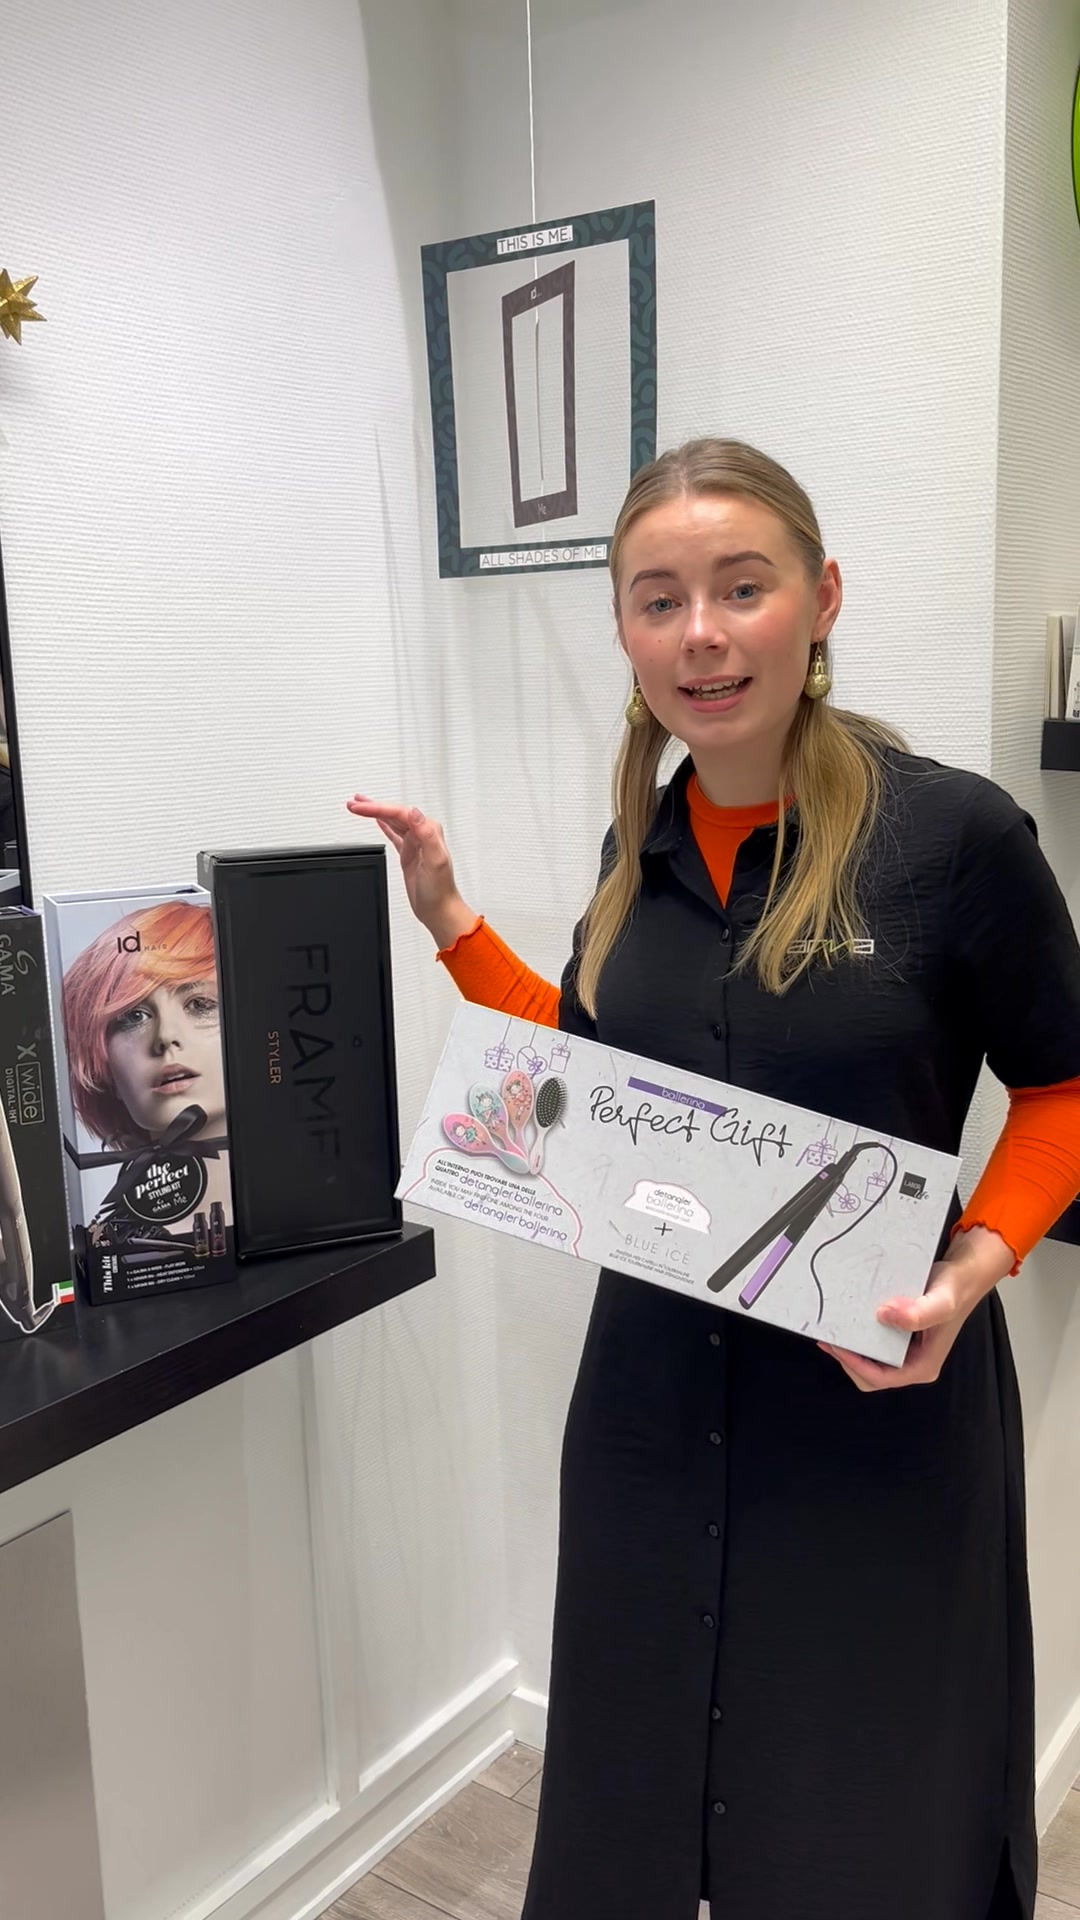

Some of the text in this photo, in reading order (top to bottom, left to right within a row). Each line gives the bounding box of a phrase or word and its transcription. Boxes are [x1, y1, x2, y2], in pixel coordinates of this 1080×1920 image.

[498, 228, 571, 252] THIS IS ME.
[481, 546, 606, 566] ALL SHADES OF ME!
[144, 944, 168, 952] HAIR
[268, 1030, 282, 1084] STYLER
[21, 1067, 40, 1119] wide
[661, 1088, 706, 1110] ballerina
[590, 1085, 793, 1166] Perfect Gift
[134, 1164, 190, 1199] perfect
[146, 1162, 170, 1178] the
[434, 1165, 459, 1177] QUATTRO
[148, 1185, 172, 1200] STYLING
[171, 1180, 182, 1192] KIT
[470, 1170, 484, 1178] PUOI
[484, 1174, 508, 1186] TROVARE
[520, 1186, 536, 1195] DELLE
[904, 1180, 922, 1190] LABOR
[500, 1201, 522, 1213] AMONG
[646, 1194, 694, 1218] ballerina
[654, 1188, 692, 1206] detangler
[624, 1234, 690, 1266] BLUE ICE
[102, 1256, 113, 1293] This kit
